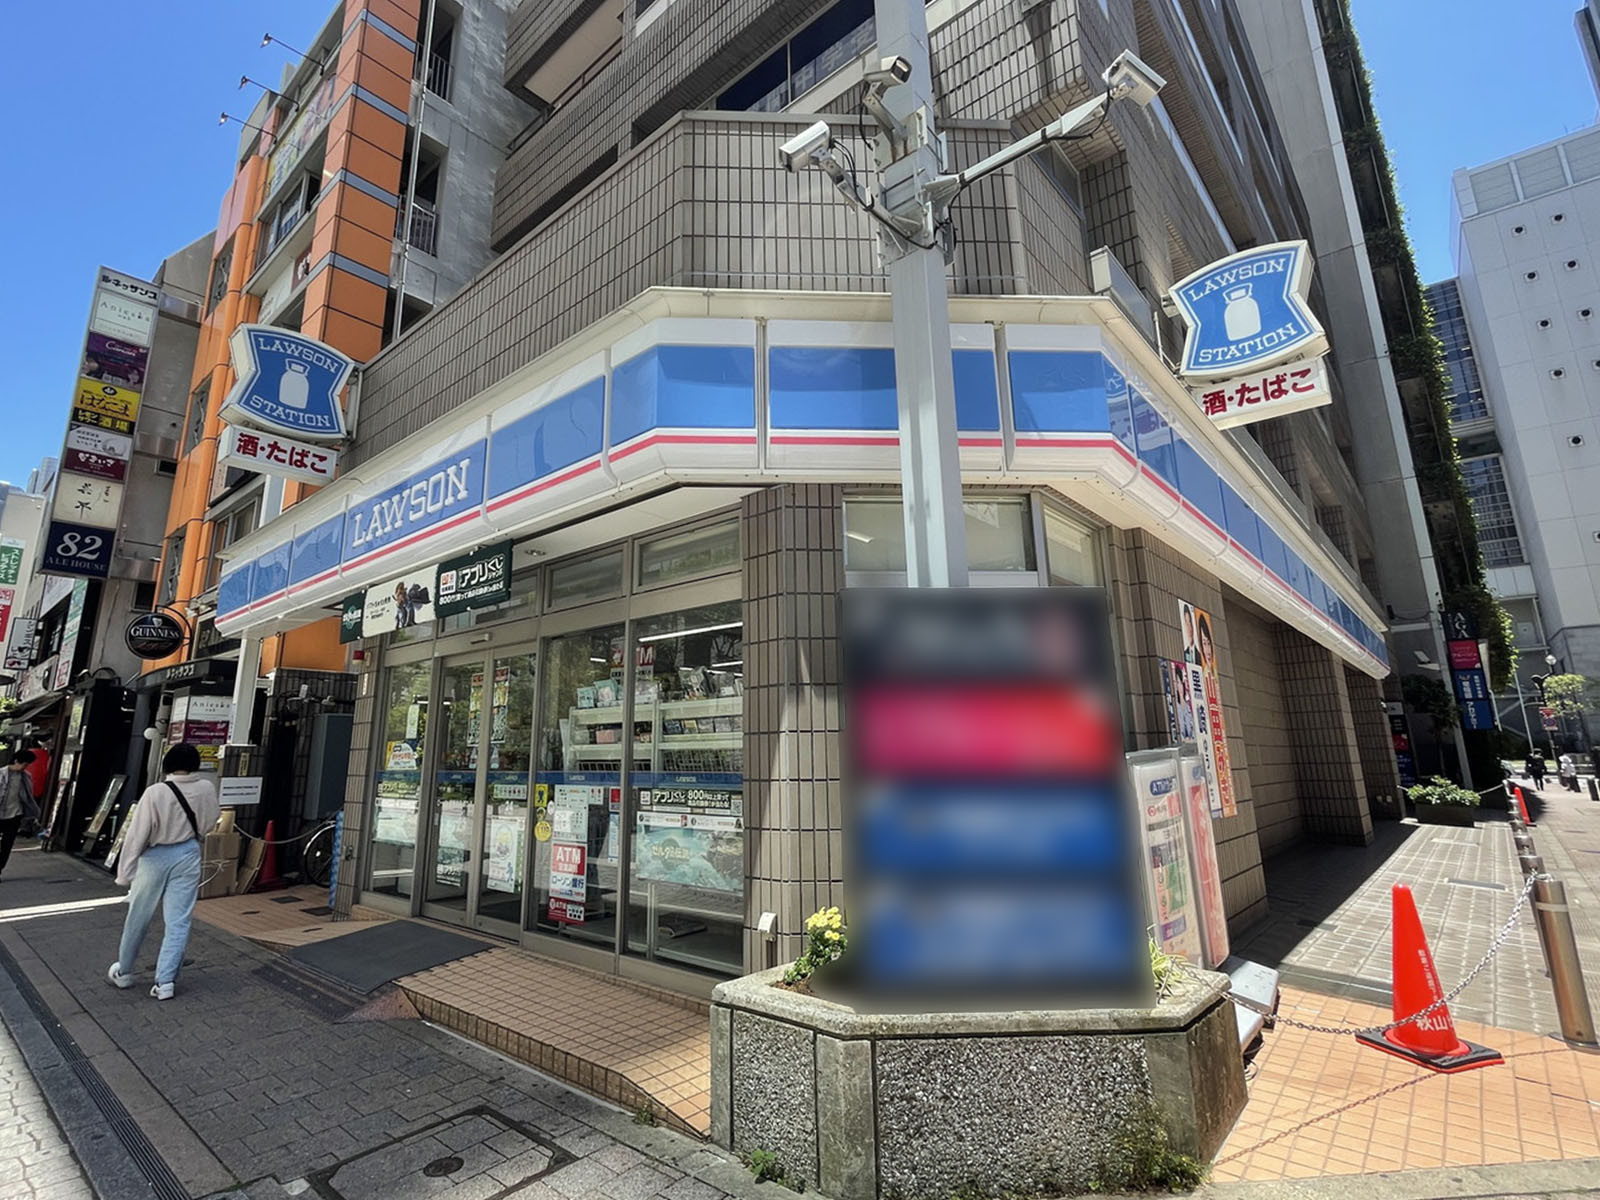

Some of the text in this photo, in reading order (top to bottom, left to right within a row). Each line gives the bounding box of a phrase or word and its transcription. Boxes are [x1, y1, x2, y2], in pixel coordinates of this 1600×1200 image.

[1188, 258, 1287, 302] LAWSON
[257, 337, 339, 374] LAWSON
[1199, 322, 1298, 363] STATION
[1202, 368, 1315, 416] 酒・たばこ
[249, 395, 331, 427] STATION
[236, 432, 328, 475] 酒・たばこ
[351, 458, 471, 548] LAWSON
[56, 532, 103, 560] 82
[46, 556, 107, 572] ALE HOUSE
[461, 555, 504, 588] アプリくじ
[131, 626, 180, 639] GUINNESS
[556, 846, 581, 864] ATM
